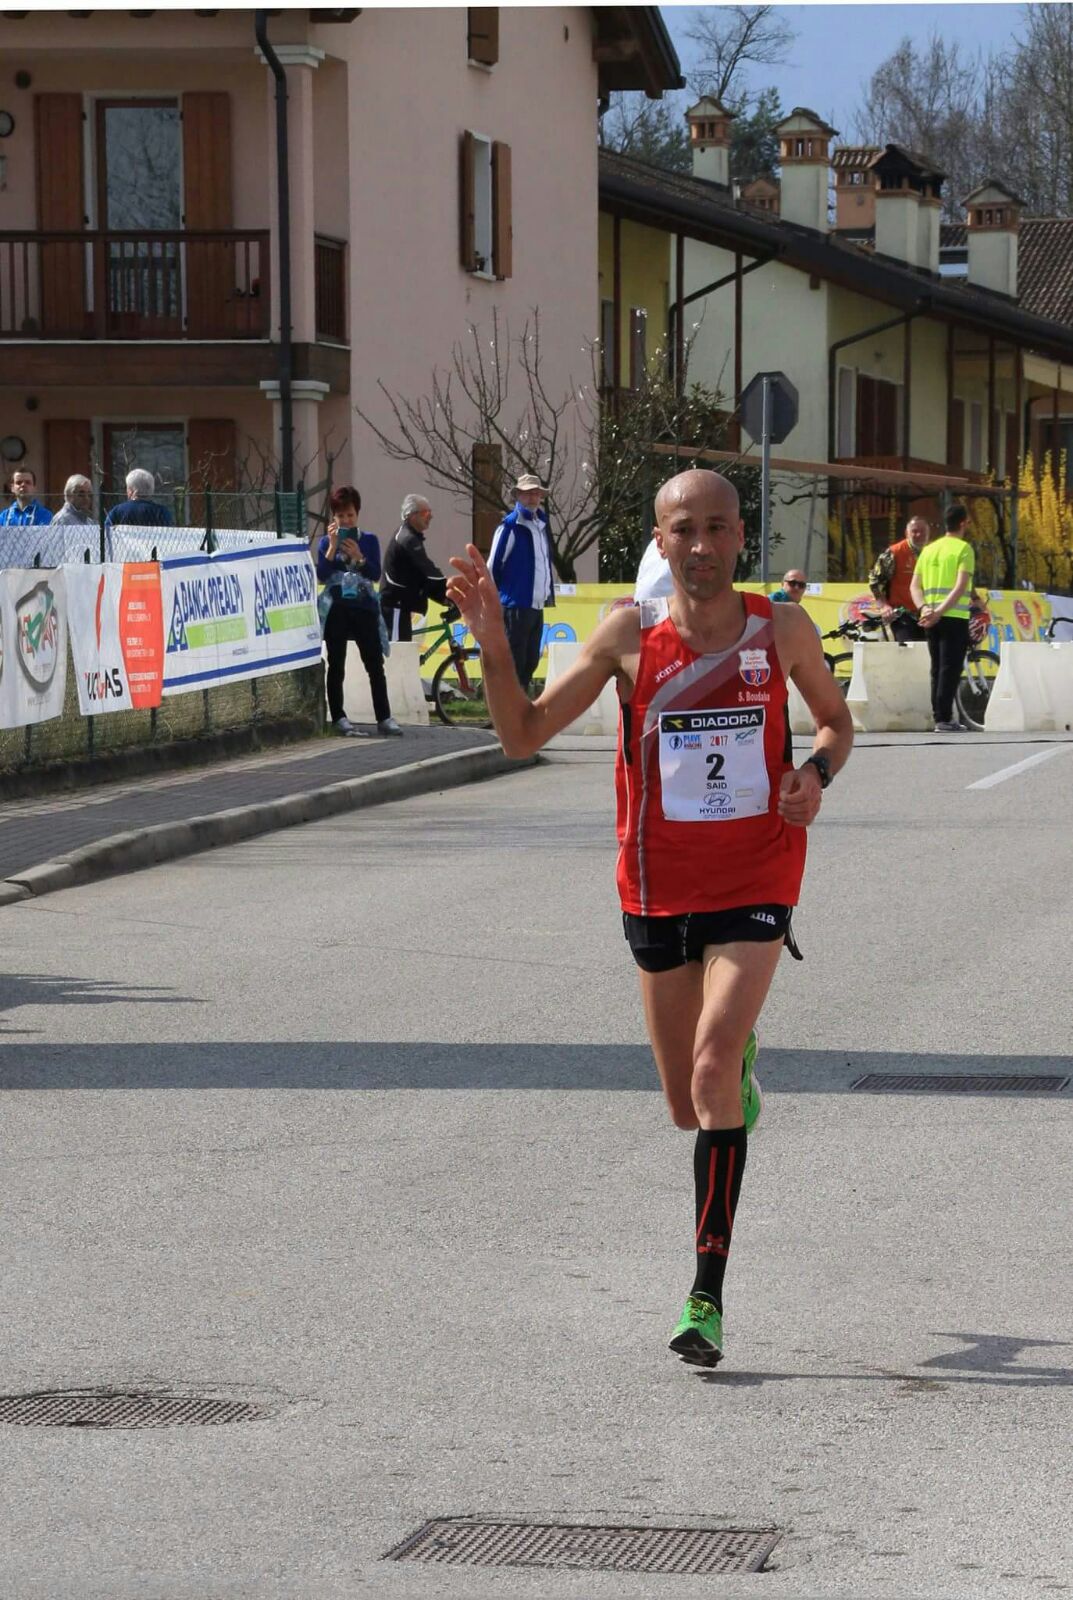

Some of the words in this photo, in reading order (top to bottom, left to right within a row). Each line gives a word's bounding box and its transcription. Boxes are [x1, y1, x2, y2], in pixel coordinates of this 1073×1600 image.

[180, 578, 211, 622] BANCA
[207, 573, 244, 617] PREALPI
[738, 691, 745, 702] S.
[691, 713, 759, 729] DIADORA
[710, 735, 729, 747] 2017
[705, 753, 726, 781] 2
[706, 782, 727, 790] SAID
[699, 807, 736, 815] HYUNDAI
